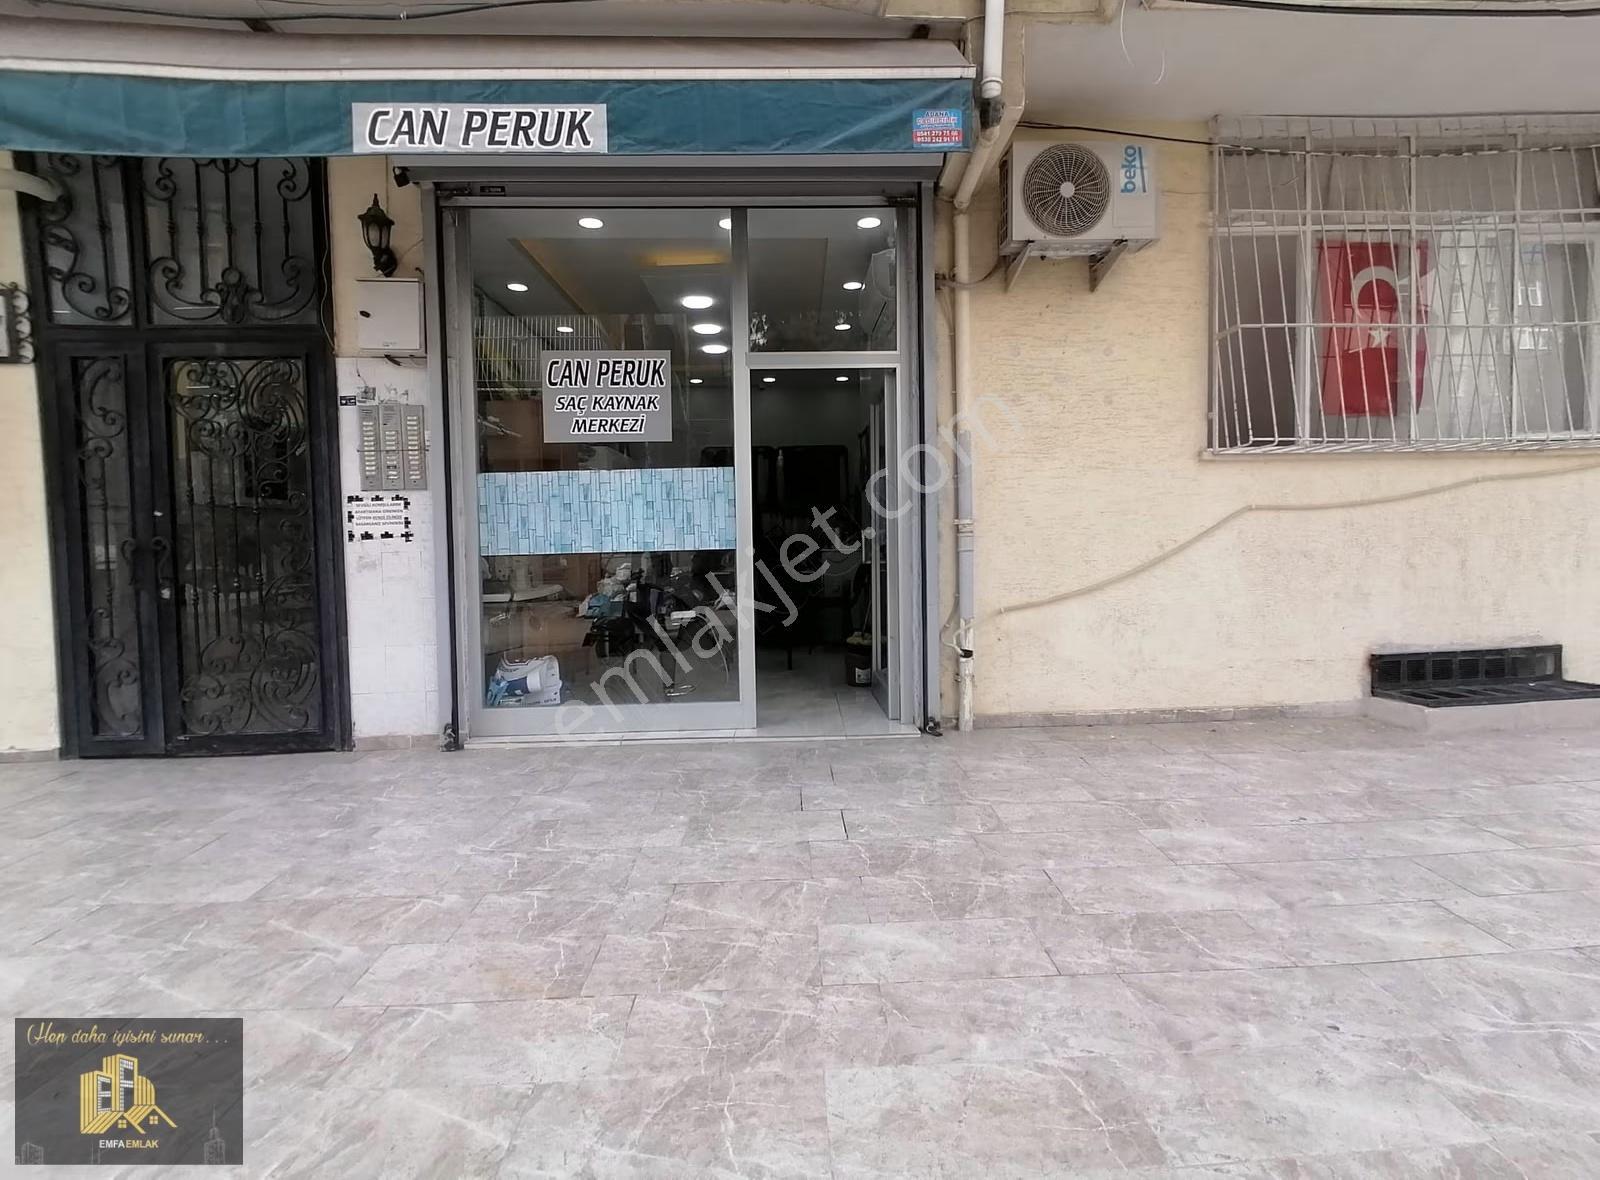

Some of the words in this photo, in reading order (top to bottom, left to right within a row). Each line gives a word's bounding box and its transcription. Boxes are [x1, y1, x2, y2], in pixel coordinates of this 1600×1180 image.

[366, 108, 450, 147] CAN
[460, 108, 594, 147] PERUK
[1120, 145, 1137, 193] beko
[546, 359, 591, 388] CAN
[595, 359, 667, 388] PERUK
[555, 395, 588, 415] SAÇ
[592, 395, 660, 411] KAYNAK
[571, 414, 646, 434] MERKEZİ
